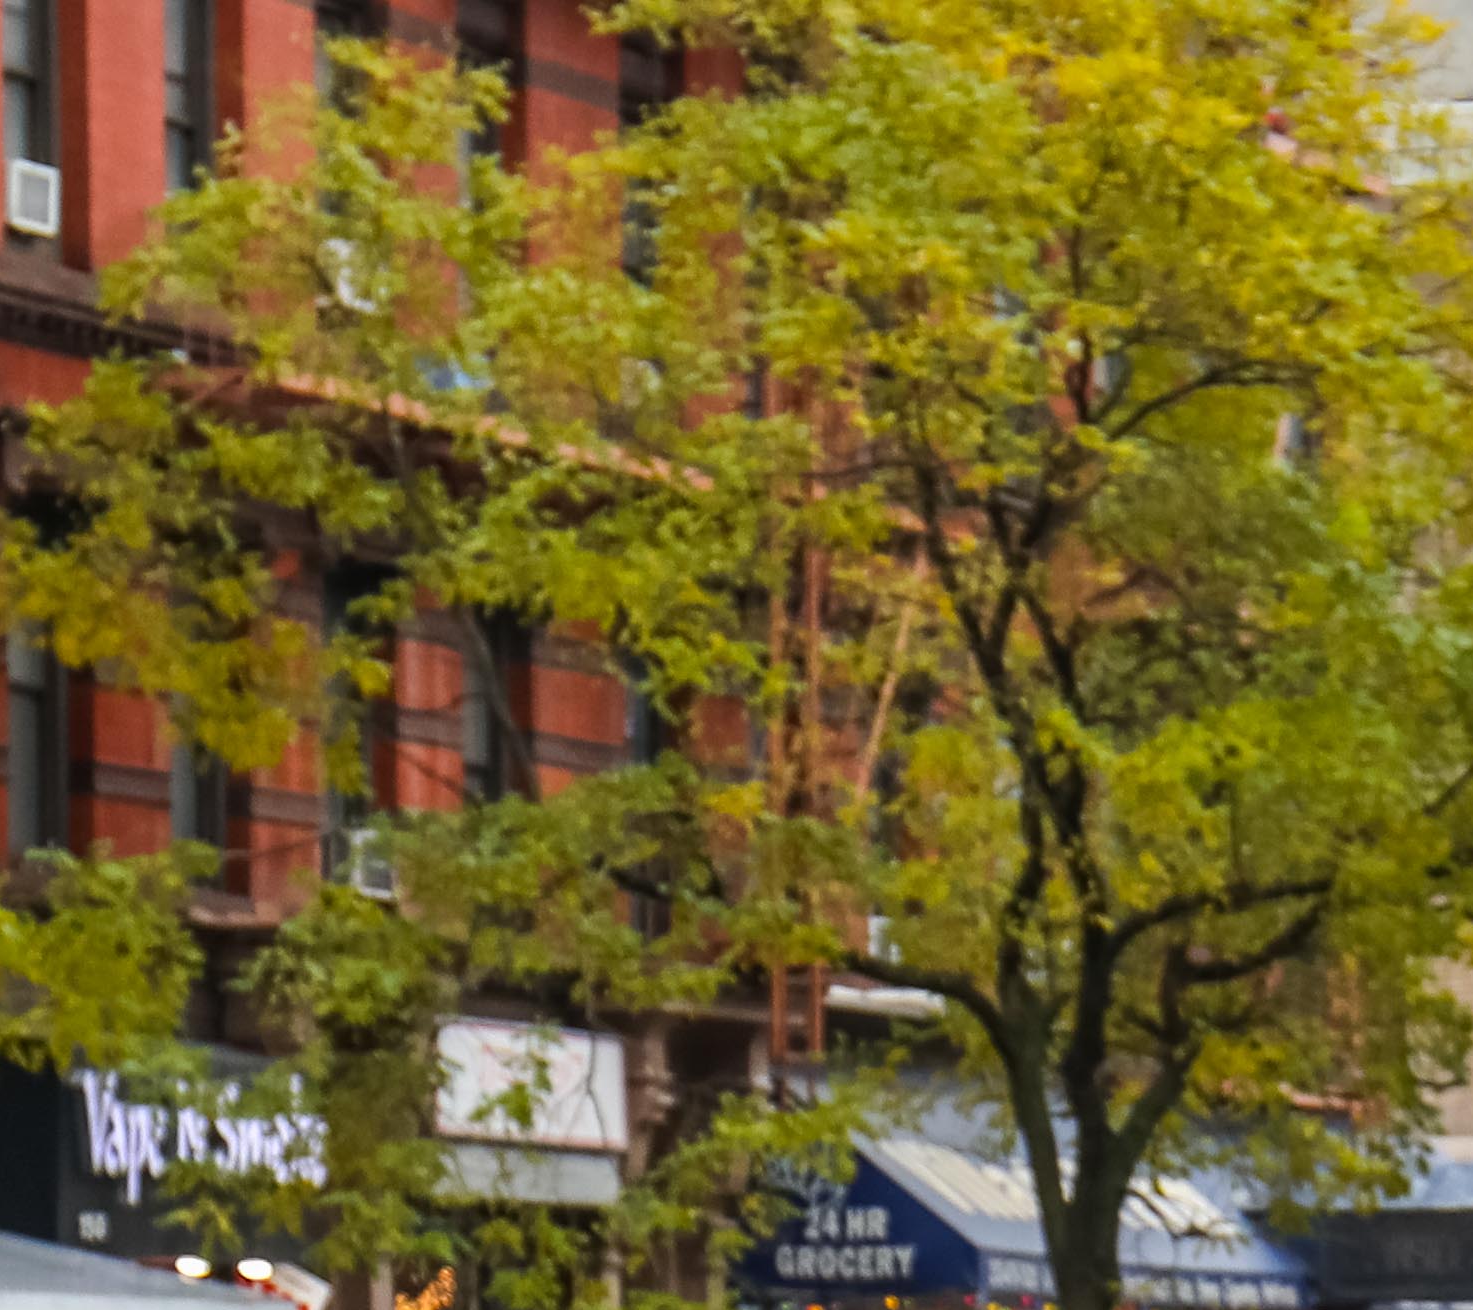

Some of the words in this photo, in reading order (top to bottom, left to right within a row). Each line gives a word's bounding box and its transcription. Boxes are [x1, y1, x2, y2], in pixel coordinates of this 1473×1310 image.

[804, 1207, 840, 1239] 24
[845, 1206, 888, 1240] HR
[776, 1244, 914, 1280] GROCERY
